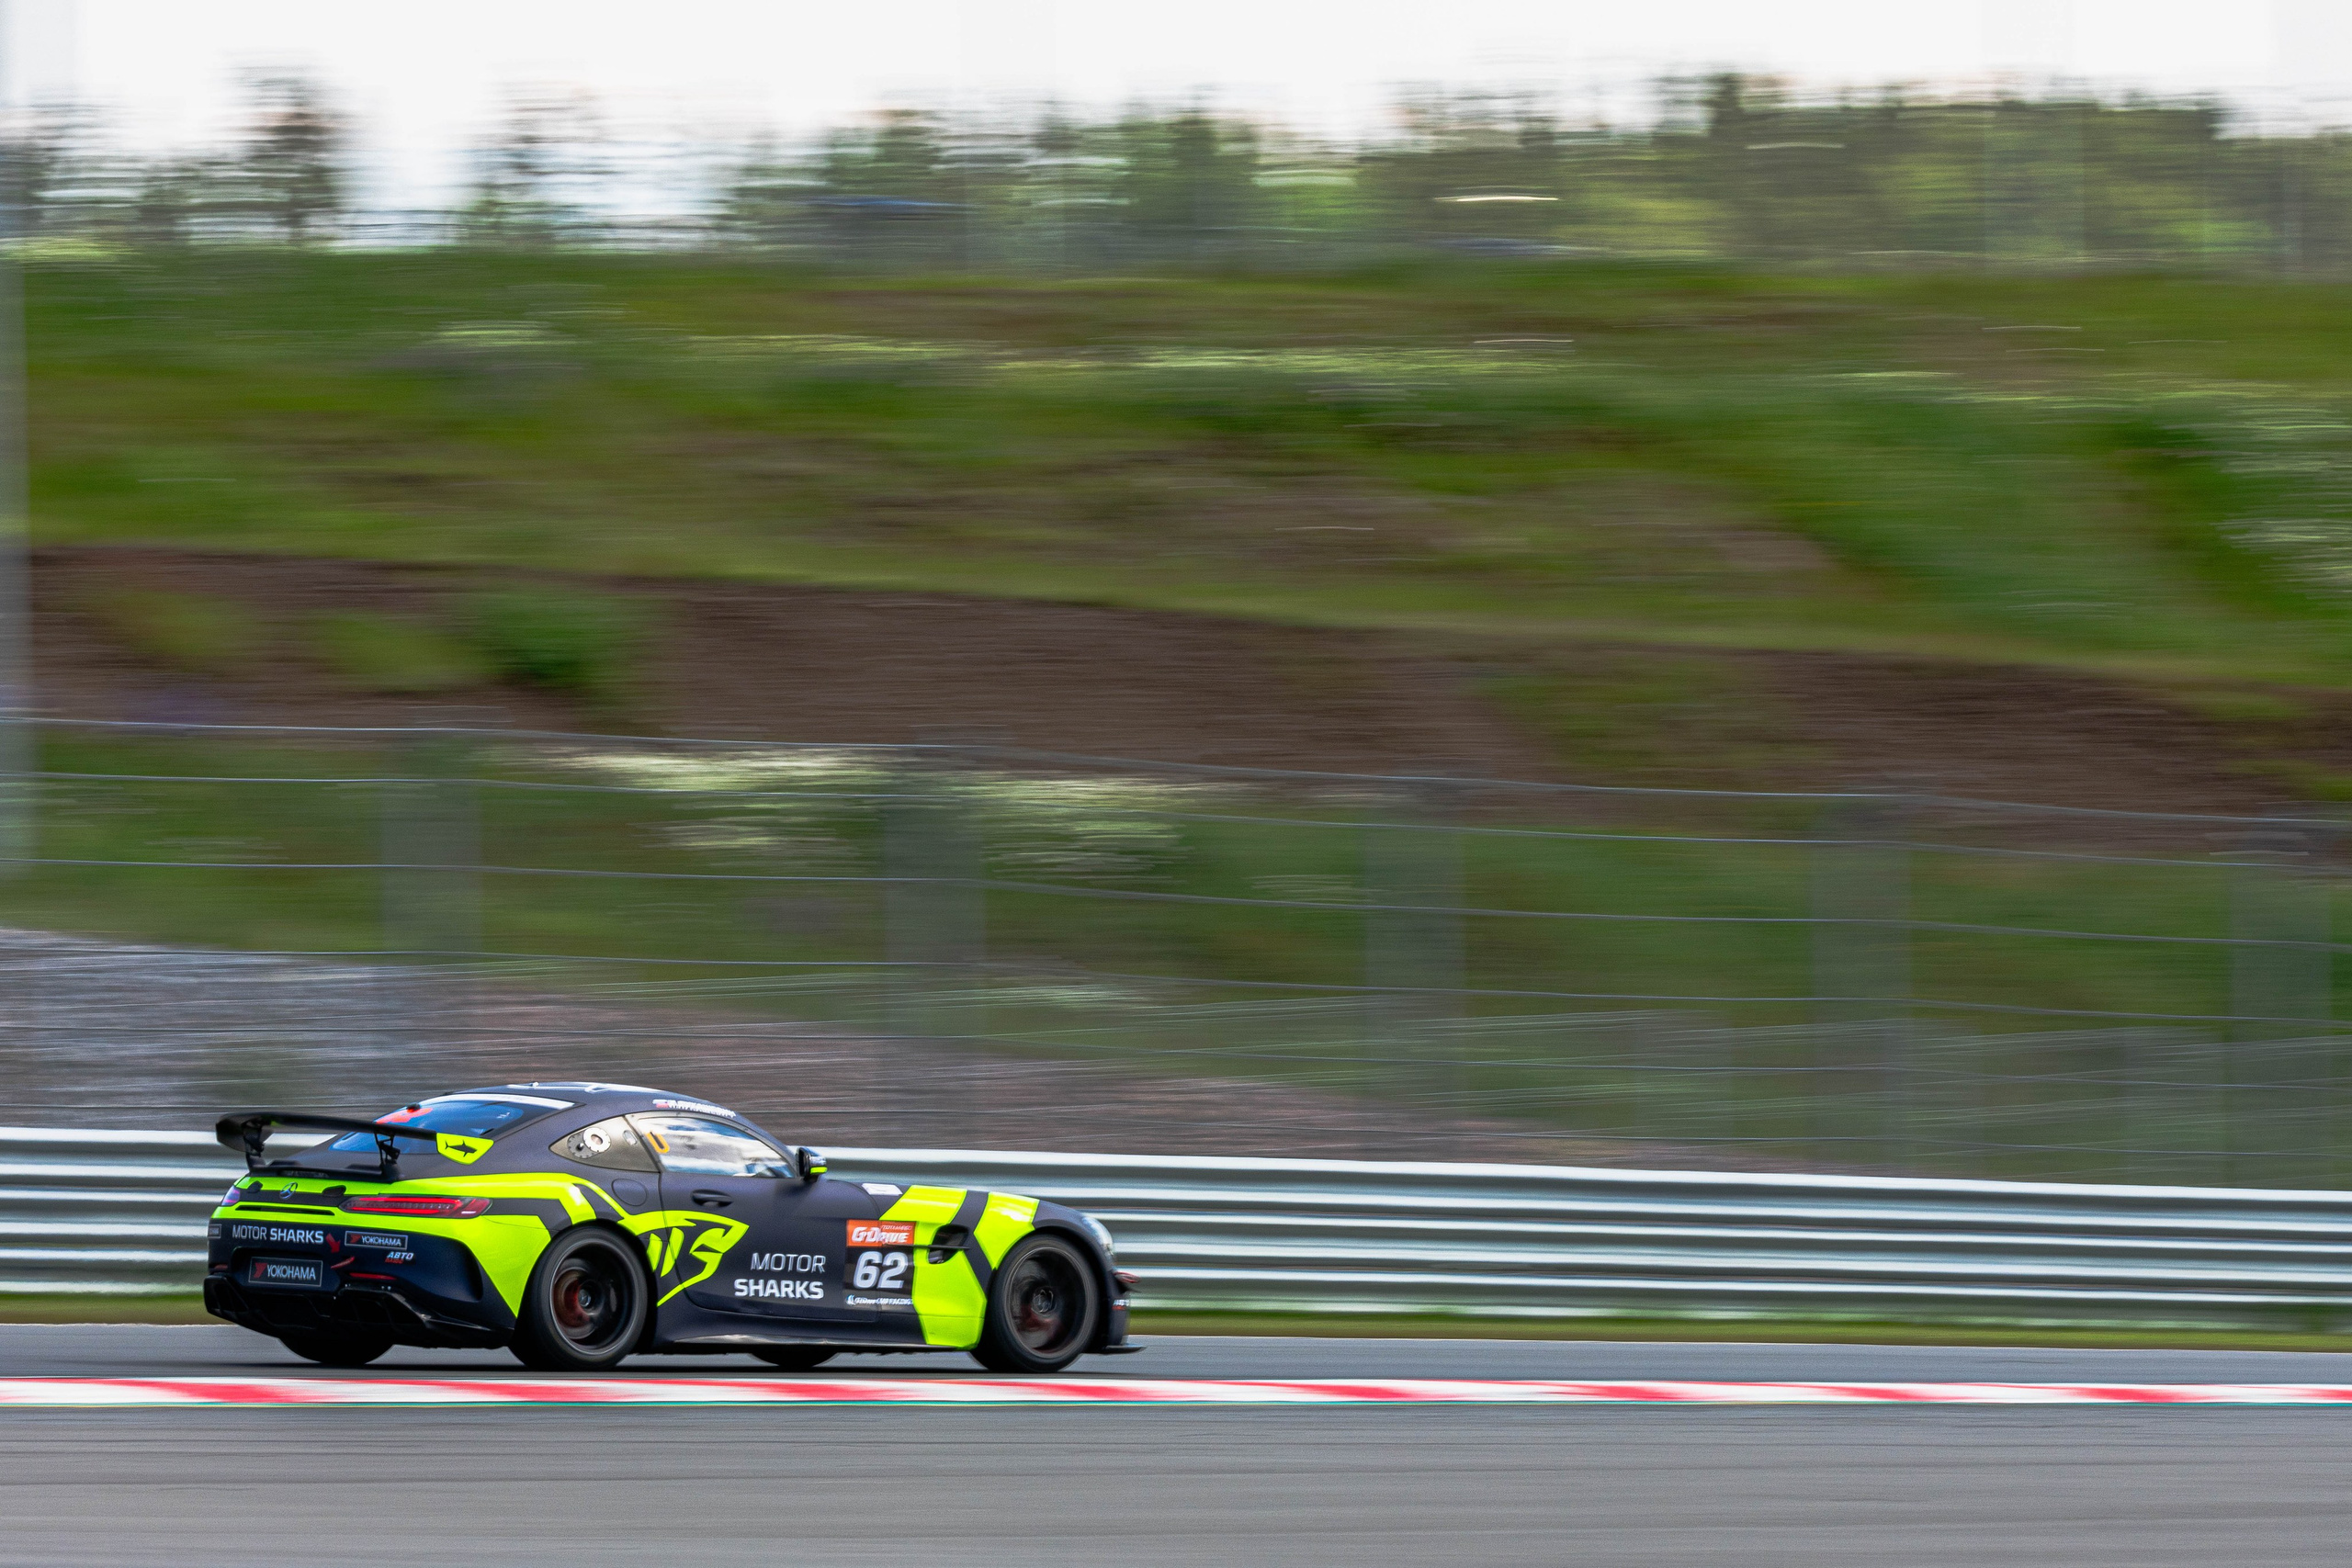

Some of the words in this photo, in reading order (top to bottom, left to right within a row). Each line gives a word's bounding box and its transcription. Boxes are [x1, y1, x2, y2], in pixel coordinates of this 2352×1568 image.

[232, 1224, 266, 1240] MOTOR
[269, 1228, 324, 1244] SHARKS
[361, 1235, 401, 1247] YOKOHAMA
[266, 1264, 316, 1280] YOKOHAMA
[751, 1252, 826, 1273] MOTOR
[853, 1251, 908, 1289] 62
[734, 1279, 824, 1300] SHARKS
